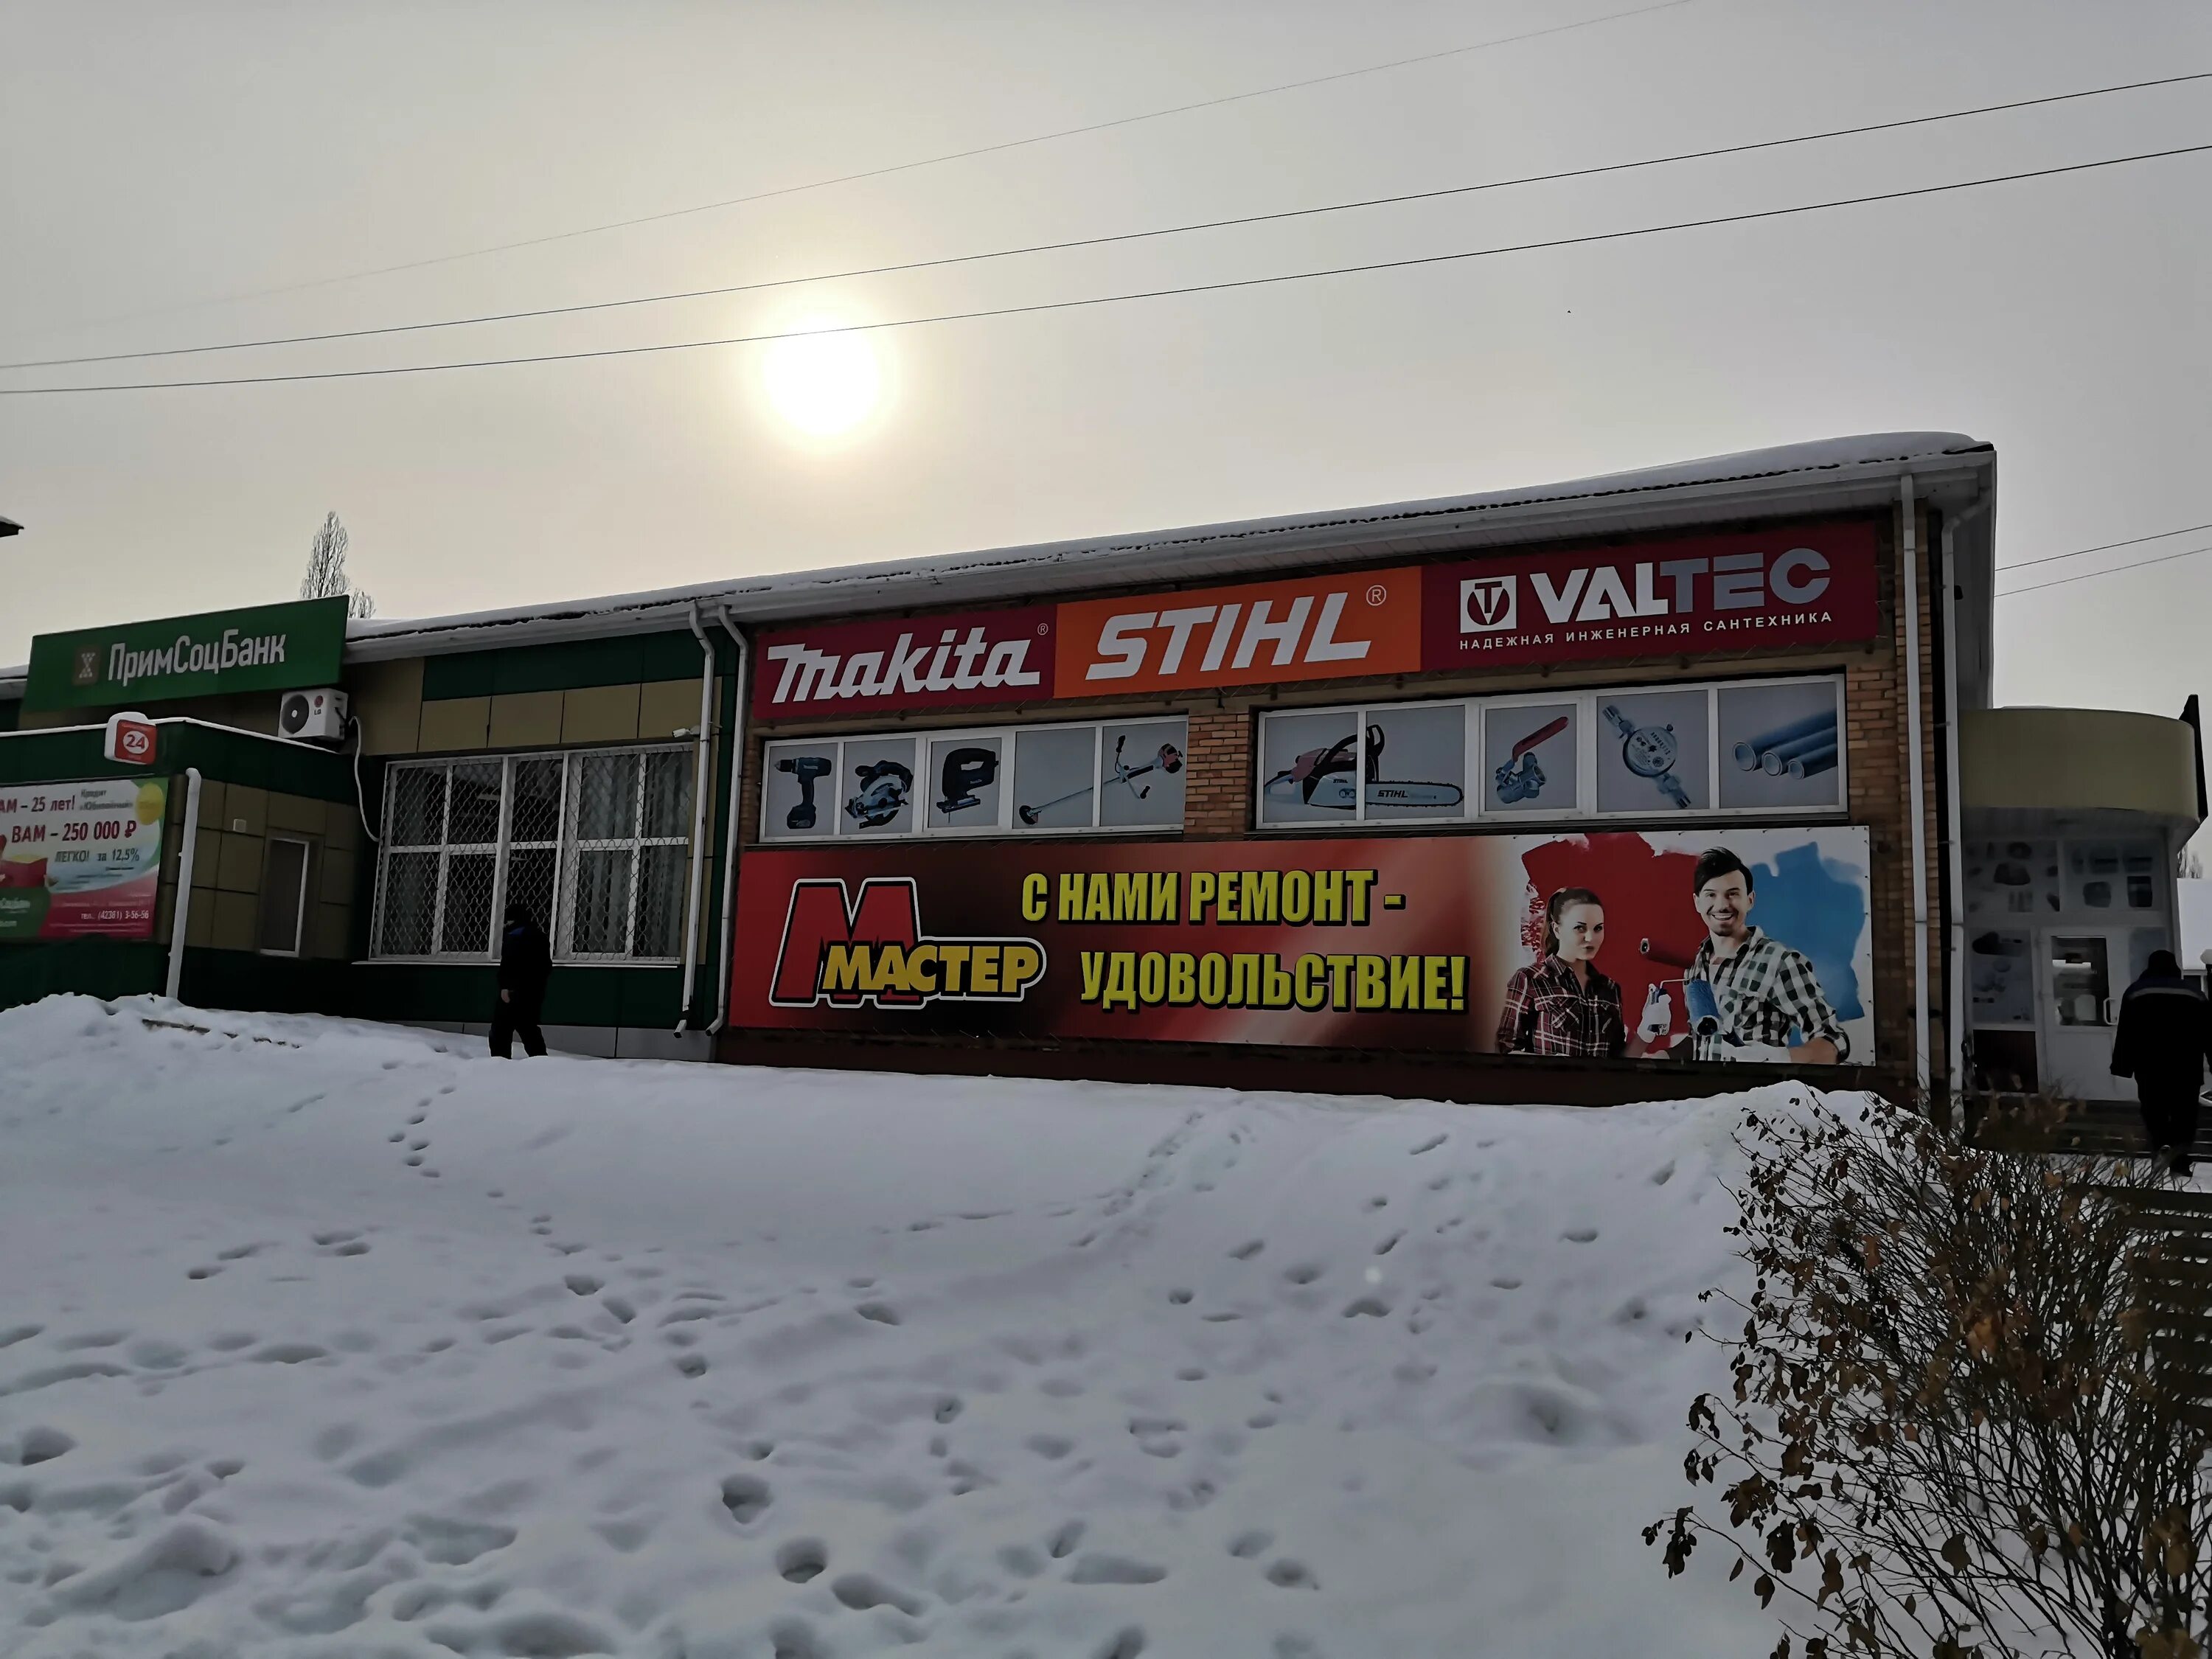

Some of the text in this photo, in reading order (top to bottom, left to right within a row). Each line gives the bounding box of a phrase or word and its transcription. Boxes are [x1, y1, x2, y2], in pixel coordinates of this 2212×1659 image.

[1529, 547, 1831, 625] VALTEC
[1085, 592, 1371, 681] STIHL
[1459, 611, 1832, 650] НАДЕЖНАЯ ИНЖЕНЕРНАЯ САНТЕХНИКА
[108, 628, 287, 686] ПримСоцБанк
[126, 734, 145, 749] 24
[31, 796, 45, 812] 25
[1377, 790, 1408, 798] STIHL
[12, 824, 46, 843] ВАМ
[62, 822, 88, 841] 250
[94, 820, 120, 840] 000
[1022, 873, 1048, 922] С
[1057, 872, 1178, 922] НАМИ
[1189, 870, 1375, 923] РЕМОНТ
[822, 945, 1039, 993] МАСТЕР
[1080, 951, 1467, 1011] УДОВОЛЬСТВИЕ!
